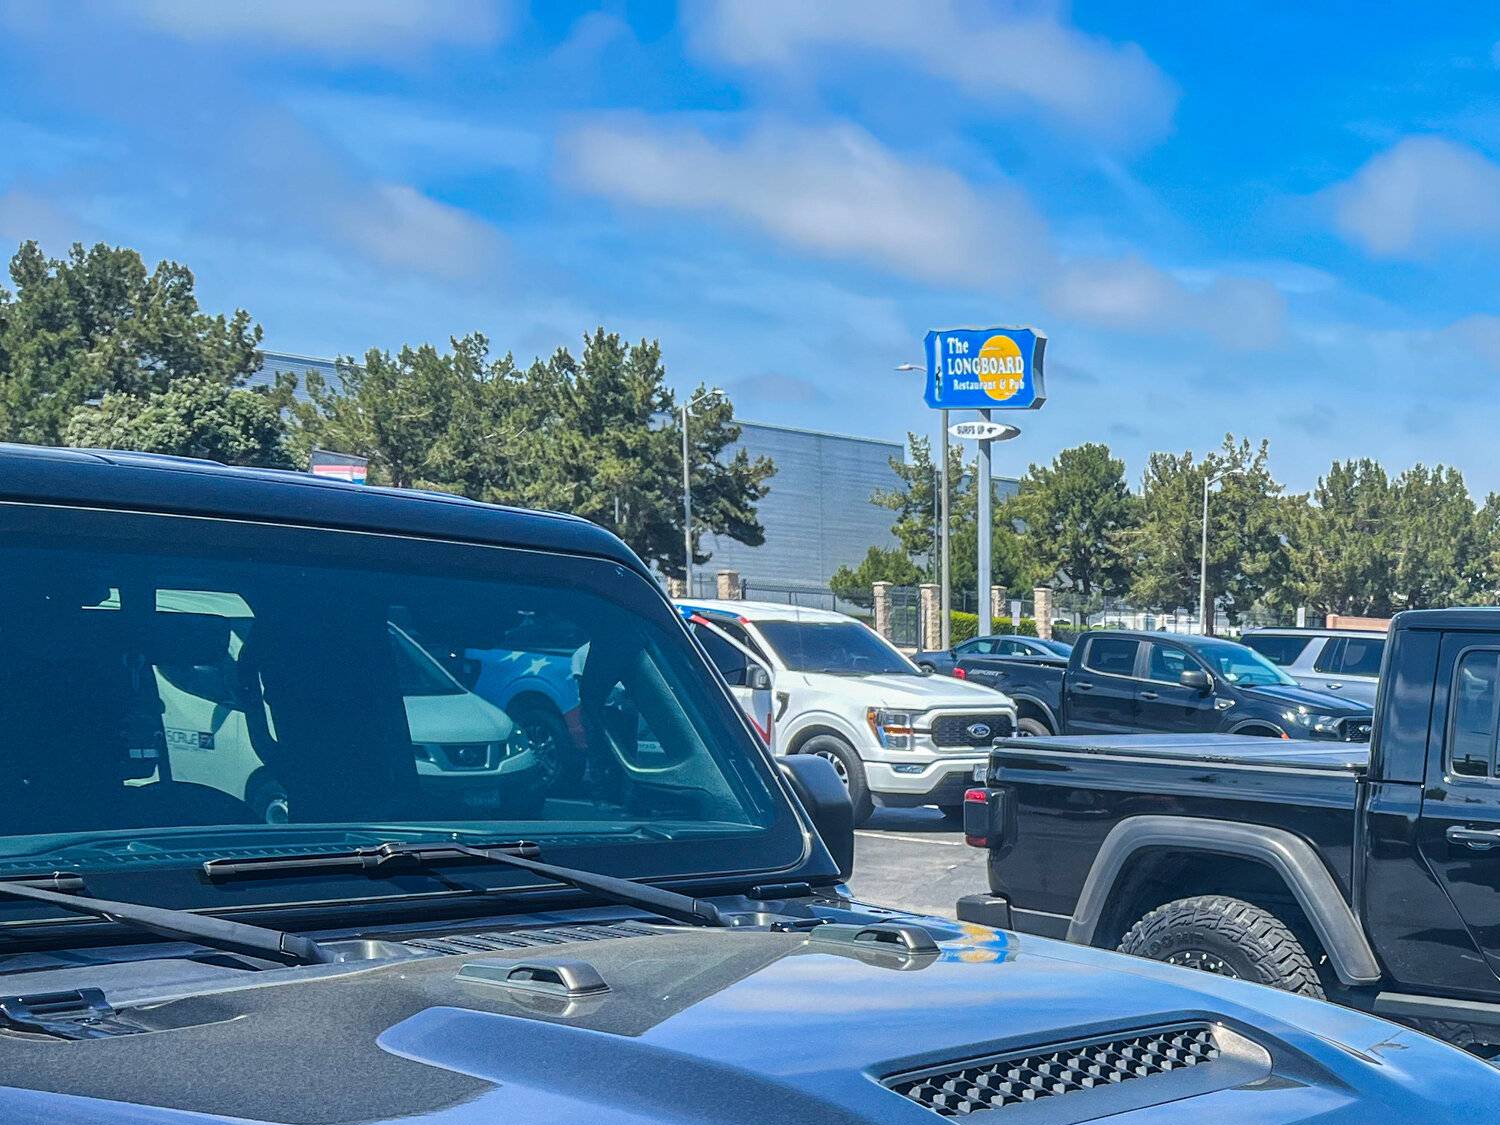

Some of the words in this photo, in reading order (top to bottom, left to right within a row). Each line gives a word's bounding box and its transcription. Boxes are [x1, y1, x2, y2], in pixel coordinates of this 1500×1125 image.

[947, 337, 969, 354] The
[947, 356, 1025, 375] LONGBOARD
[953, 379, 996, 391] Restaurant
[1009, 379, 1025, 390] Pub
